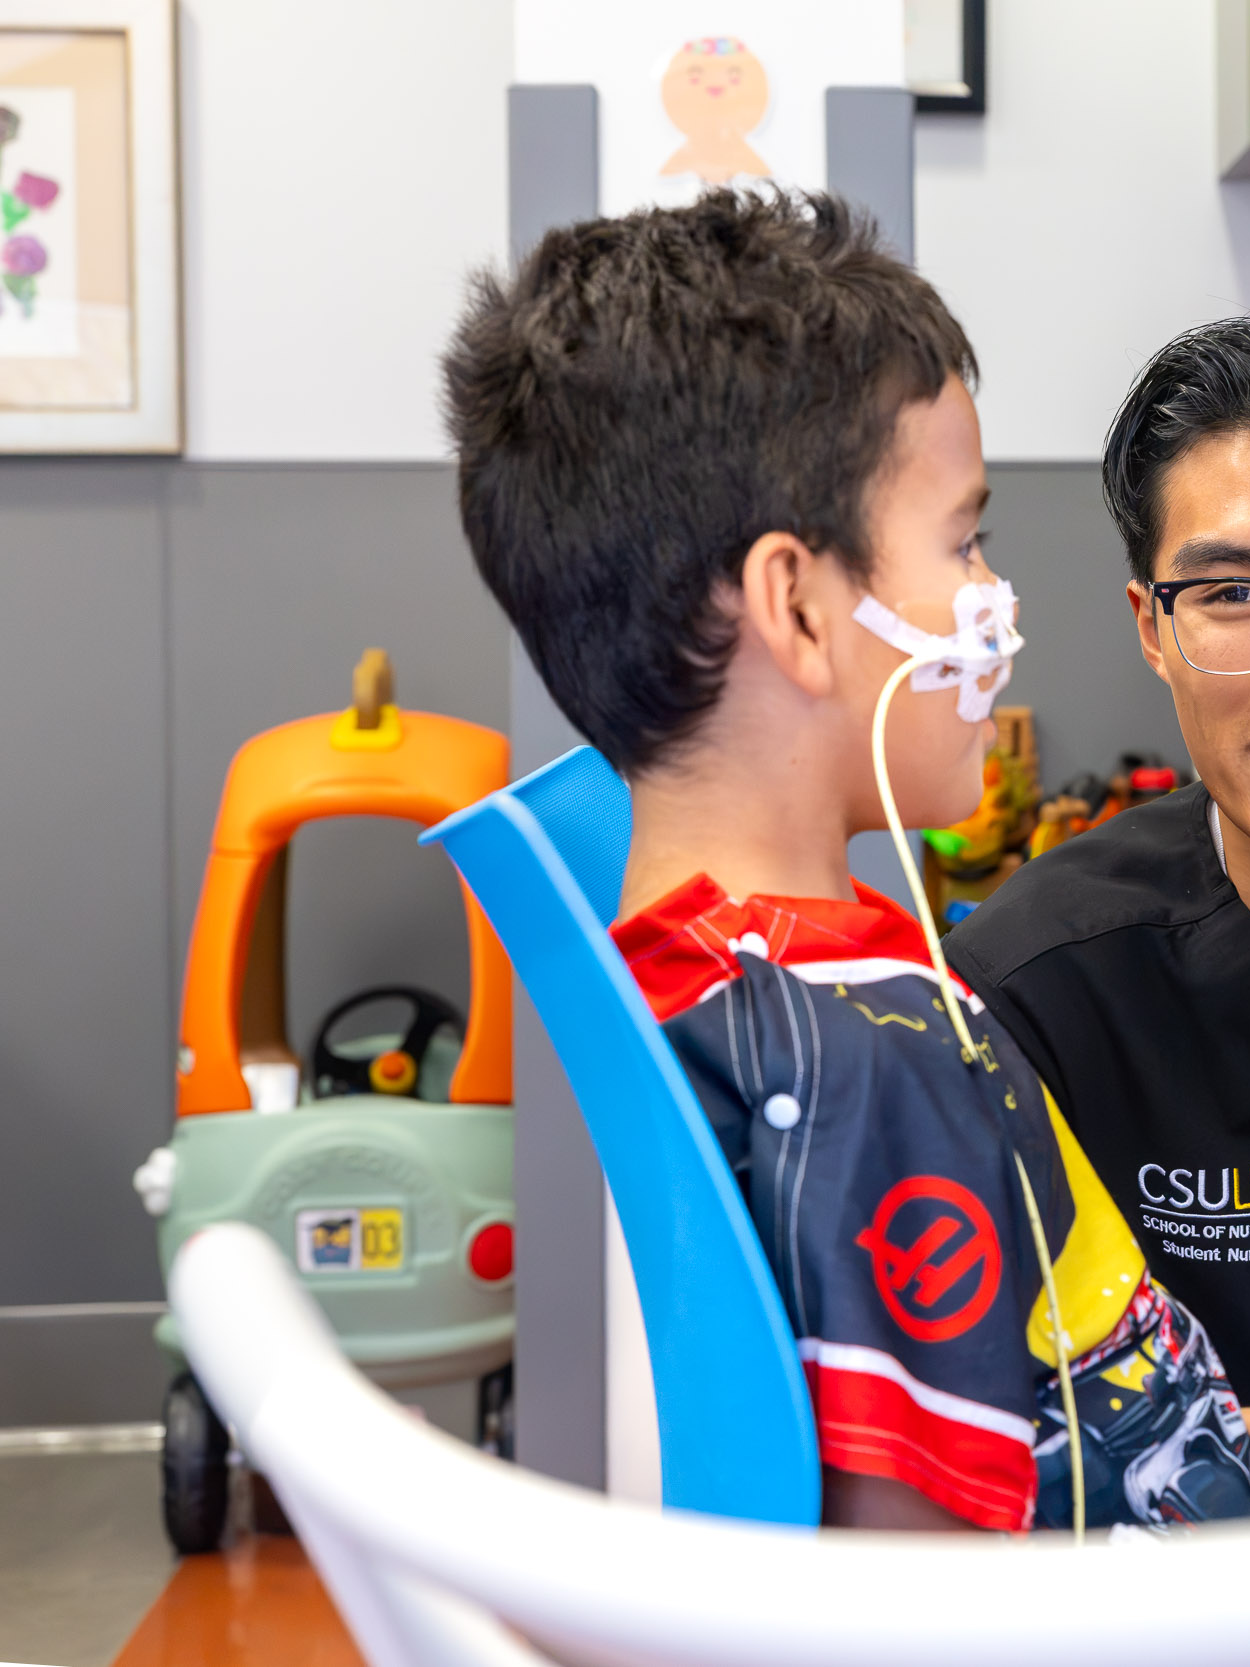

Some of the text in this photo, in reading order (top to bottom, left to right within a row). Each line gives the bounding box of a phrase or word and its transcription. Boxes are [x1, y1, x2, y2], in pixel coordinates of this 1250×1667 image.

[1143, 1214, 1200, 1238] SCHOOL
[1203, 1225, 1226, 1239] OF
[361, 1219, 399, 1260] 03
[1162, 1239, 1221, 1262] Student
